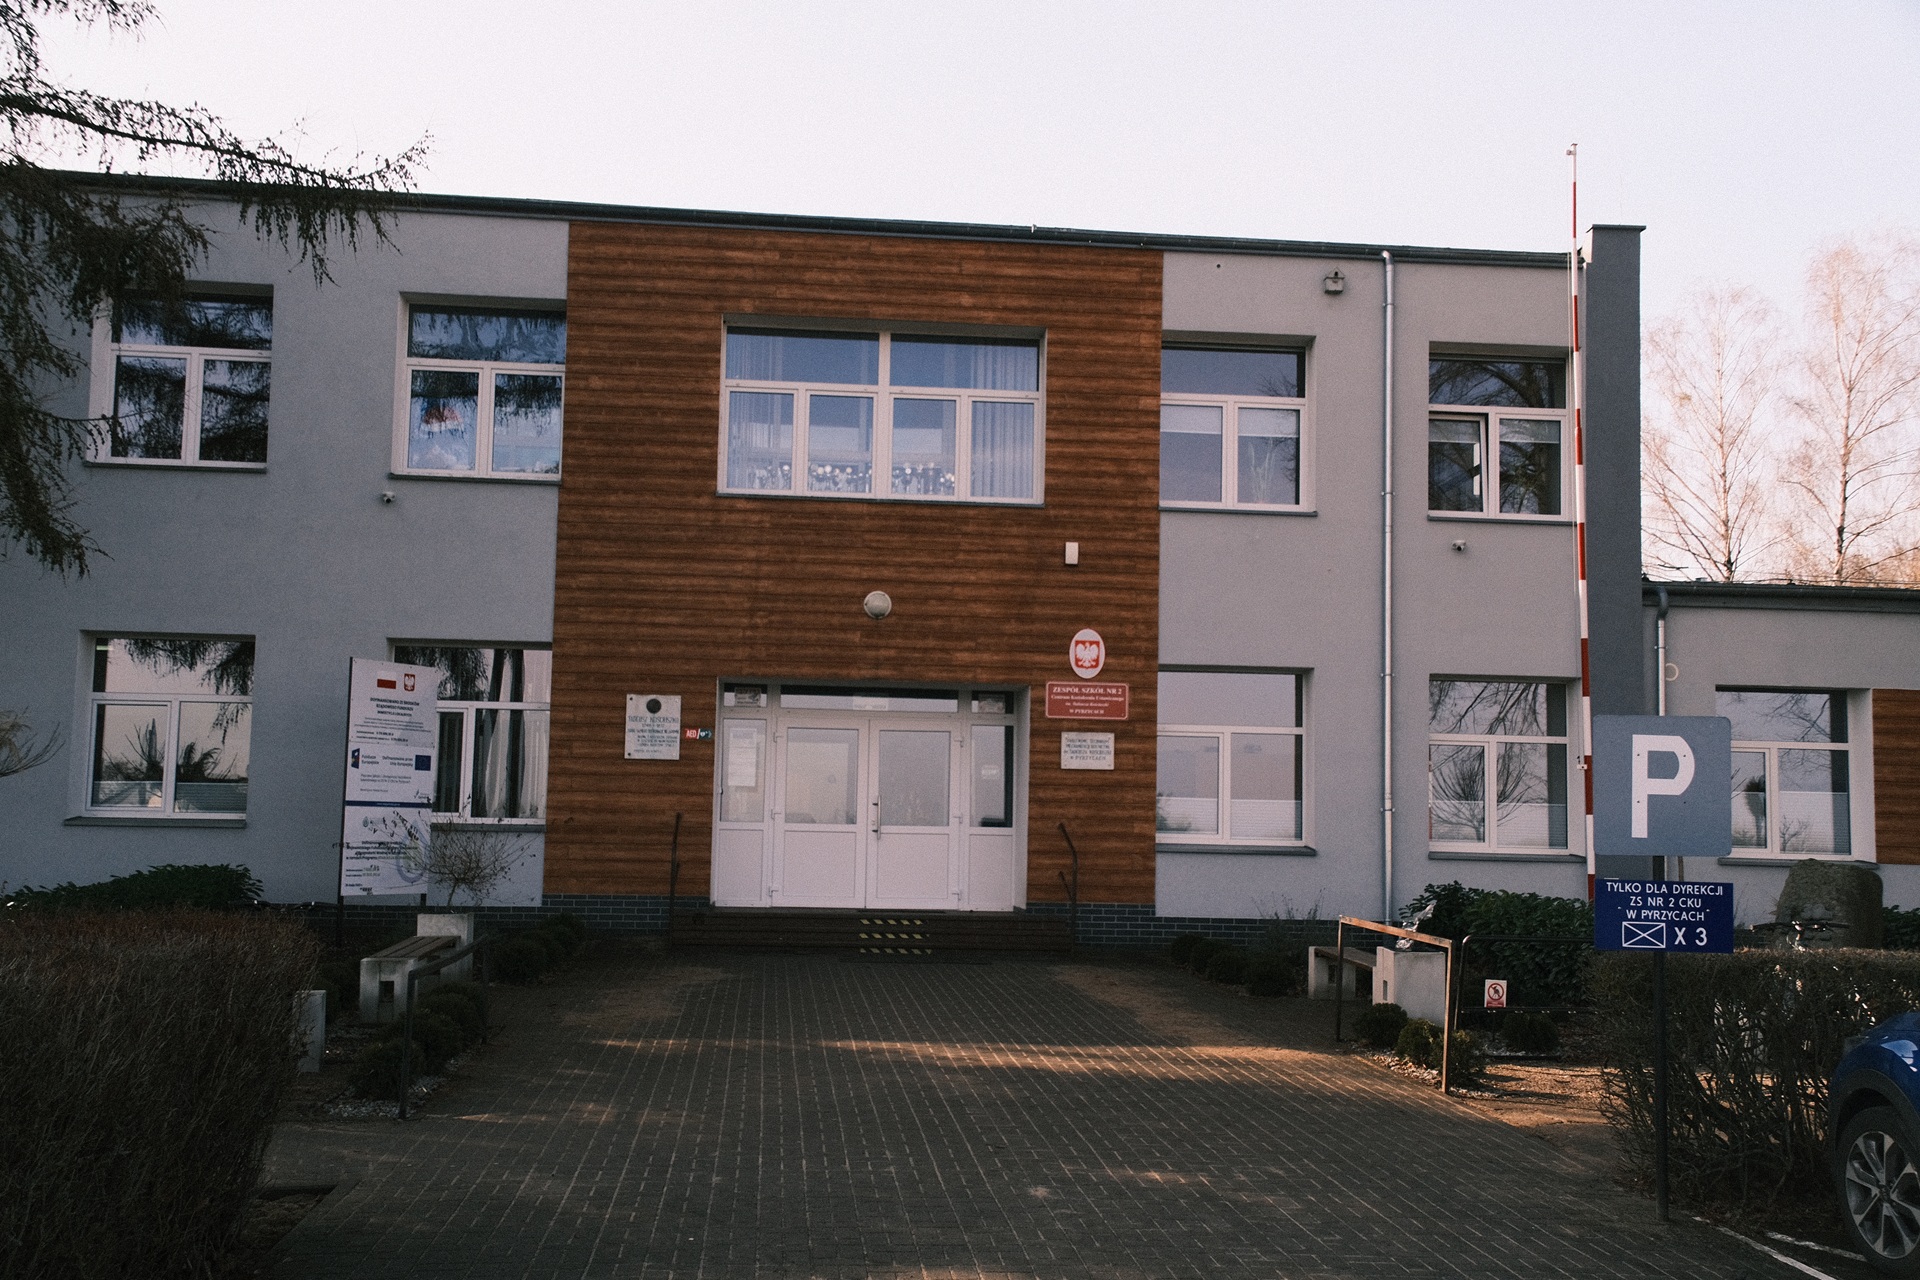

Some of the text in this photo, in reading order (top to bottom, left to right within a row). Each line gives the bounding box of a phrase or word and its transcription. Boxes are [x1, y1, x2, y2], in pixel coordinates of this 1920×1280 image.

[686, 729, 696, 738] AED
[1631, 734, 1695, 838] P
[1606, 882, 1723, 896] TYLKO DLA DYREKCJI
[1630, 896, 1702, 908] ZS NR 2 CKU
[1626, 910, 1704, 921] W PYRZYCACH
[1674, 927, 1707, 946] X 3
